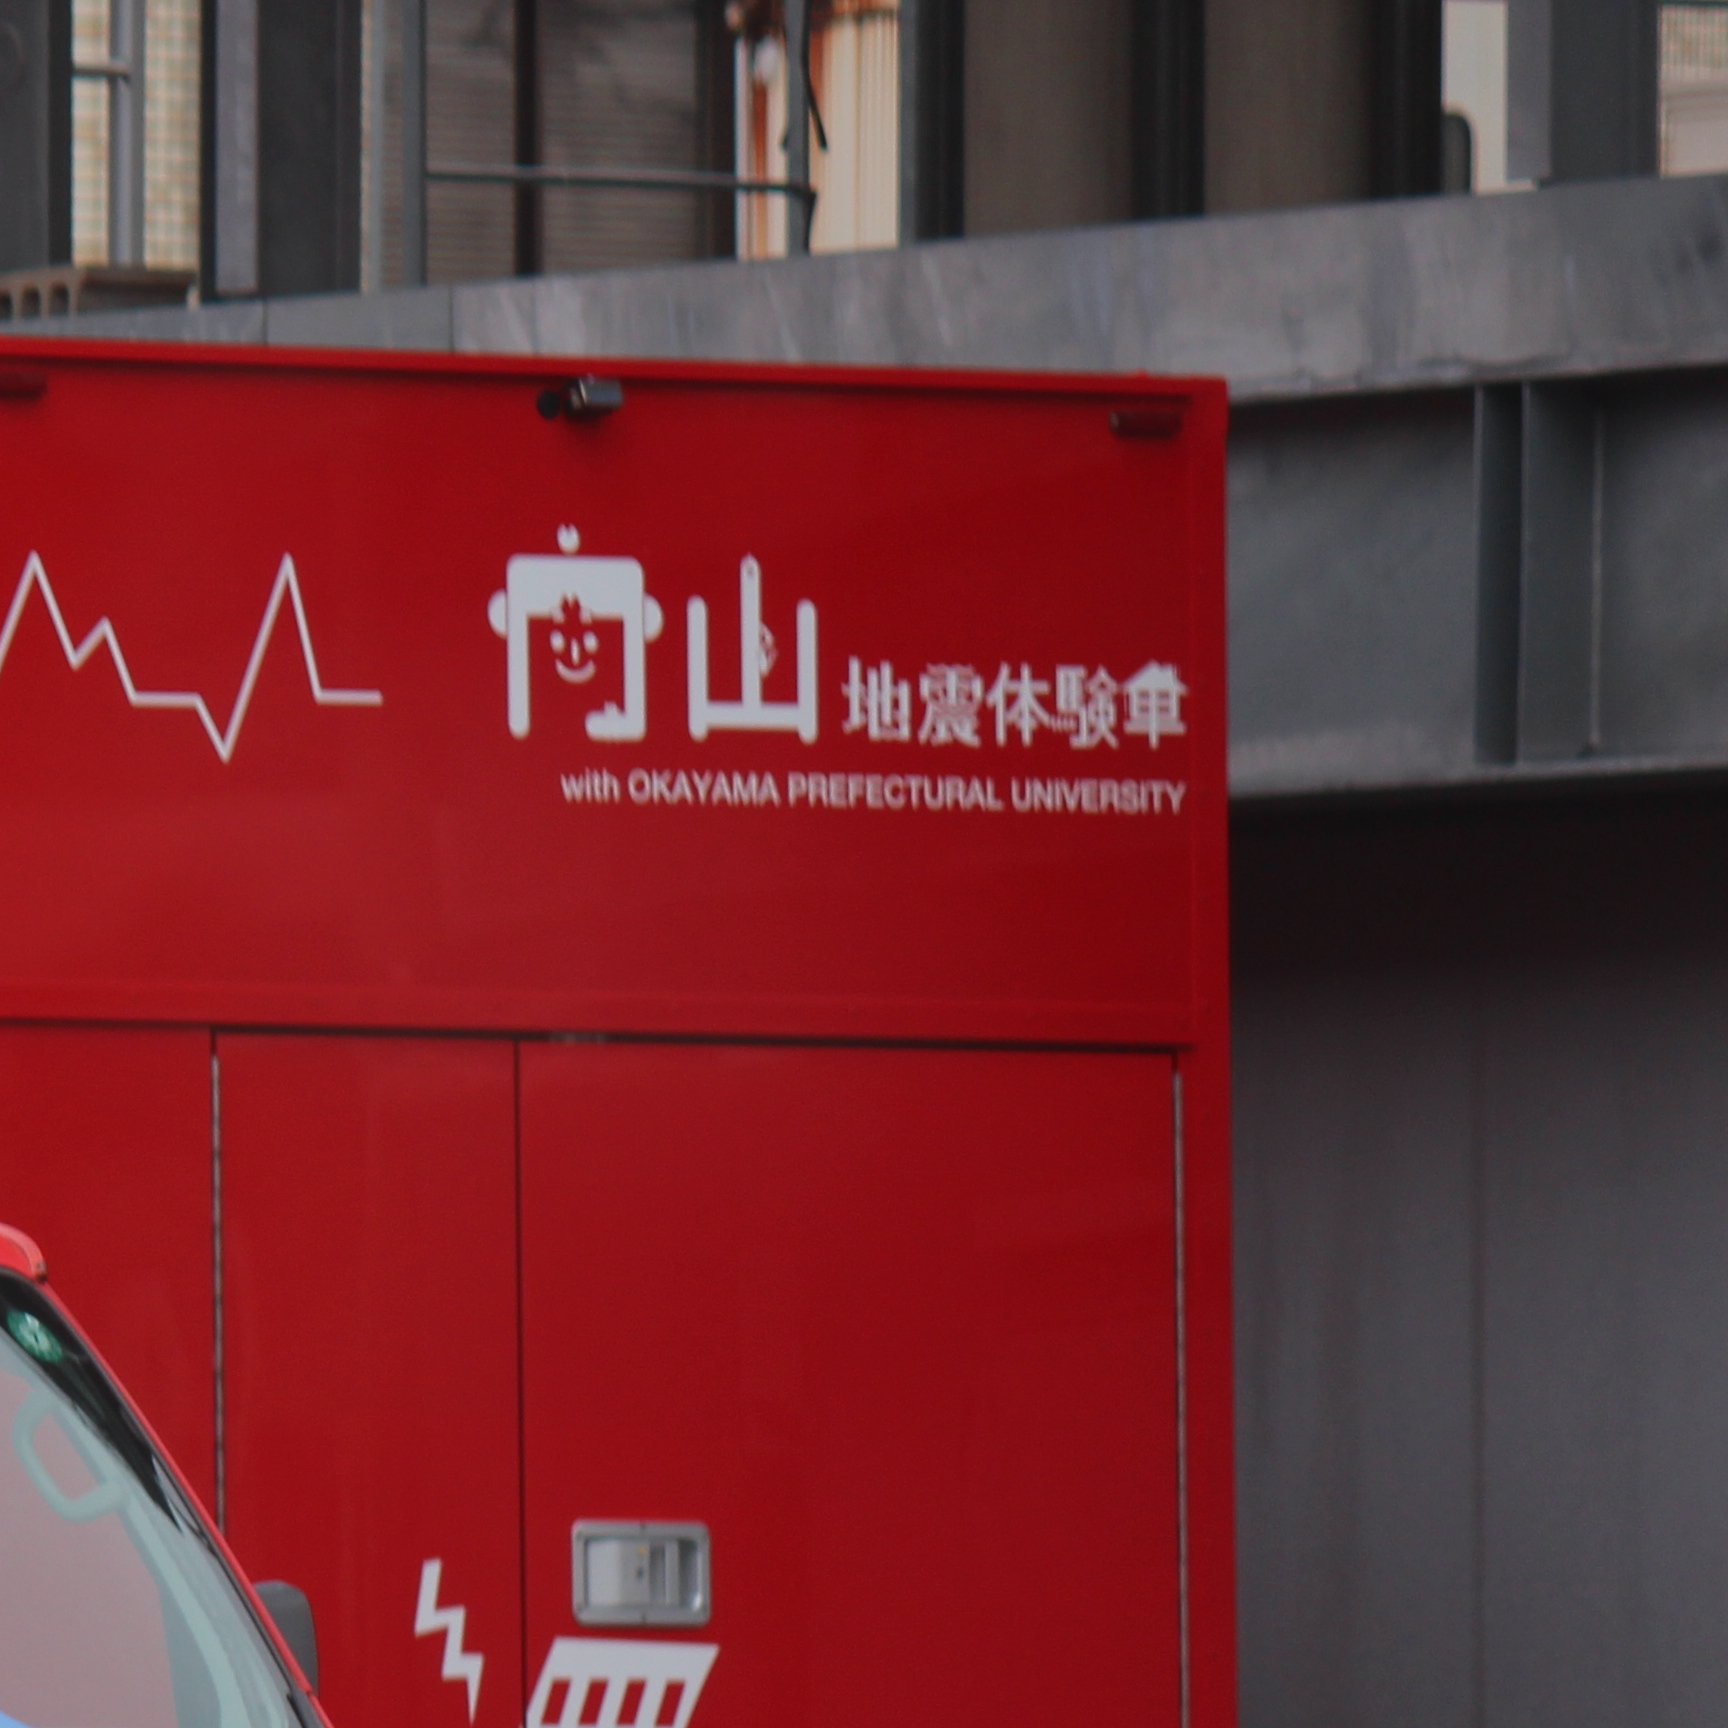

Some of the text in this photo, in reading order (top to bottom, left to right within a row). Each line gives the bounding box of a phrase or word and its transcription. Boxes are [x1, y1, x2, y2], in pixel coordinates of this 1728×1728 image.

[841, 656, 1189, 751] 地震体験車
[559, 767, 1187, 815] with OKAYAMA PREFECTURAL UNIVERSITY
